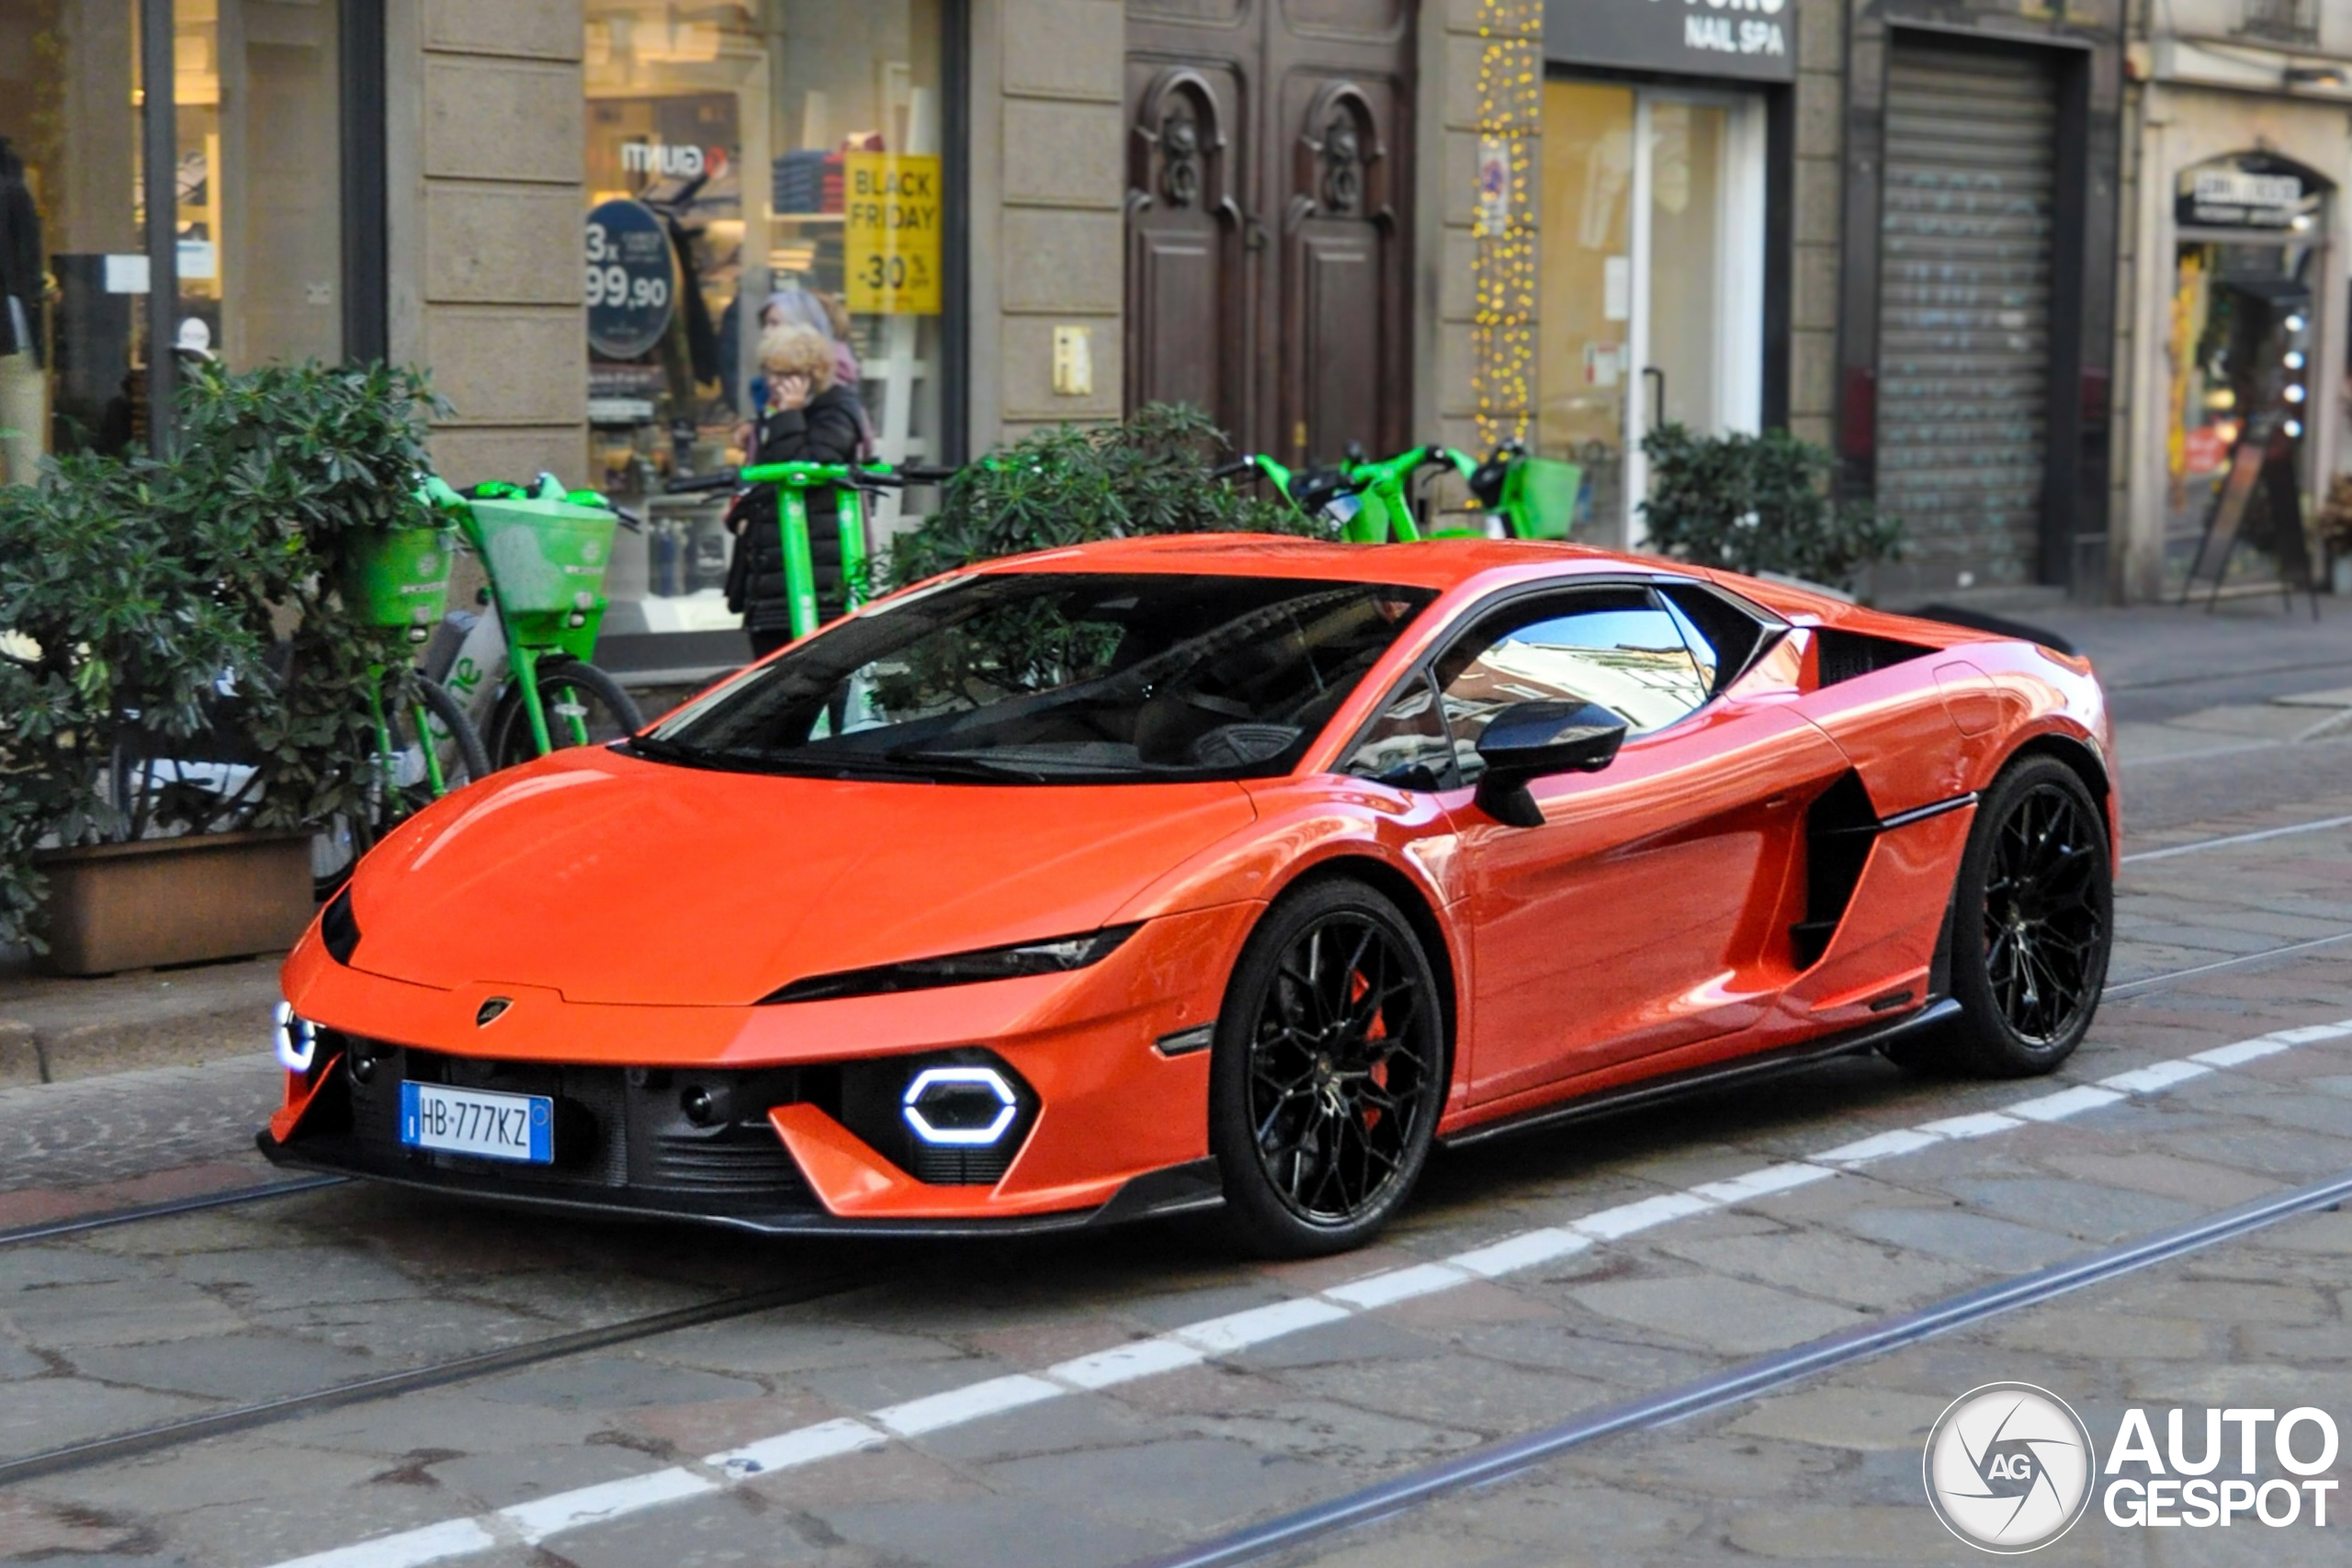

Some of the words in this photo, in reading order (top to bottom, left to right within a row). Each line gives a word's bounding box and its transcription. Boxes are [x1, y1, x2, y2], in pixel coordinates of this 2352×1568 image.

[1684, 14, 1737, 52] NAIL
[1738, 18, 1785, 56] SPA
[855, 169, 932, 197] BLACK
[851, 203, 935, 230] FRIDAY
